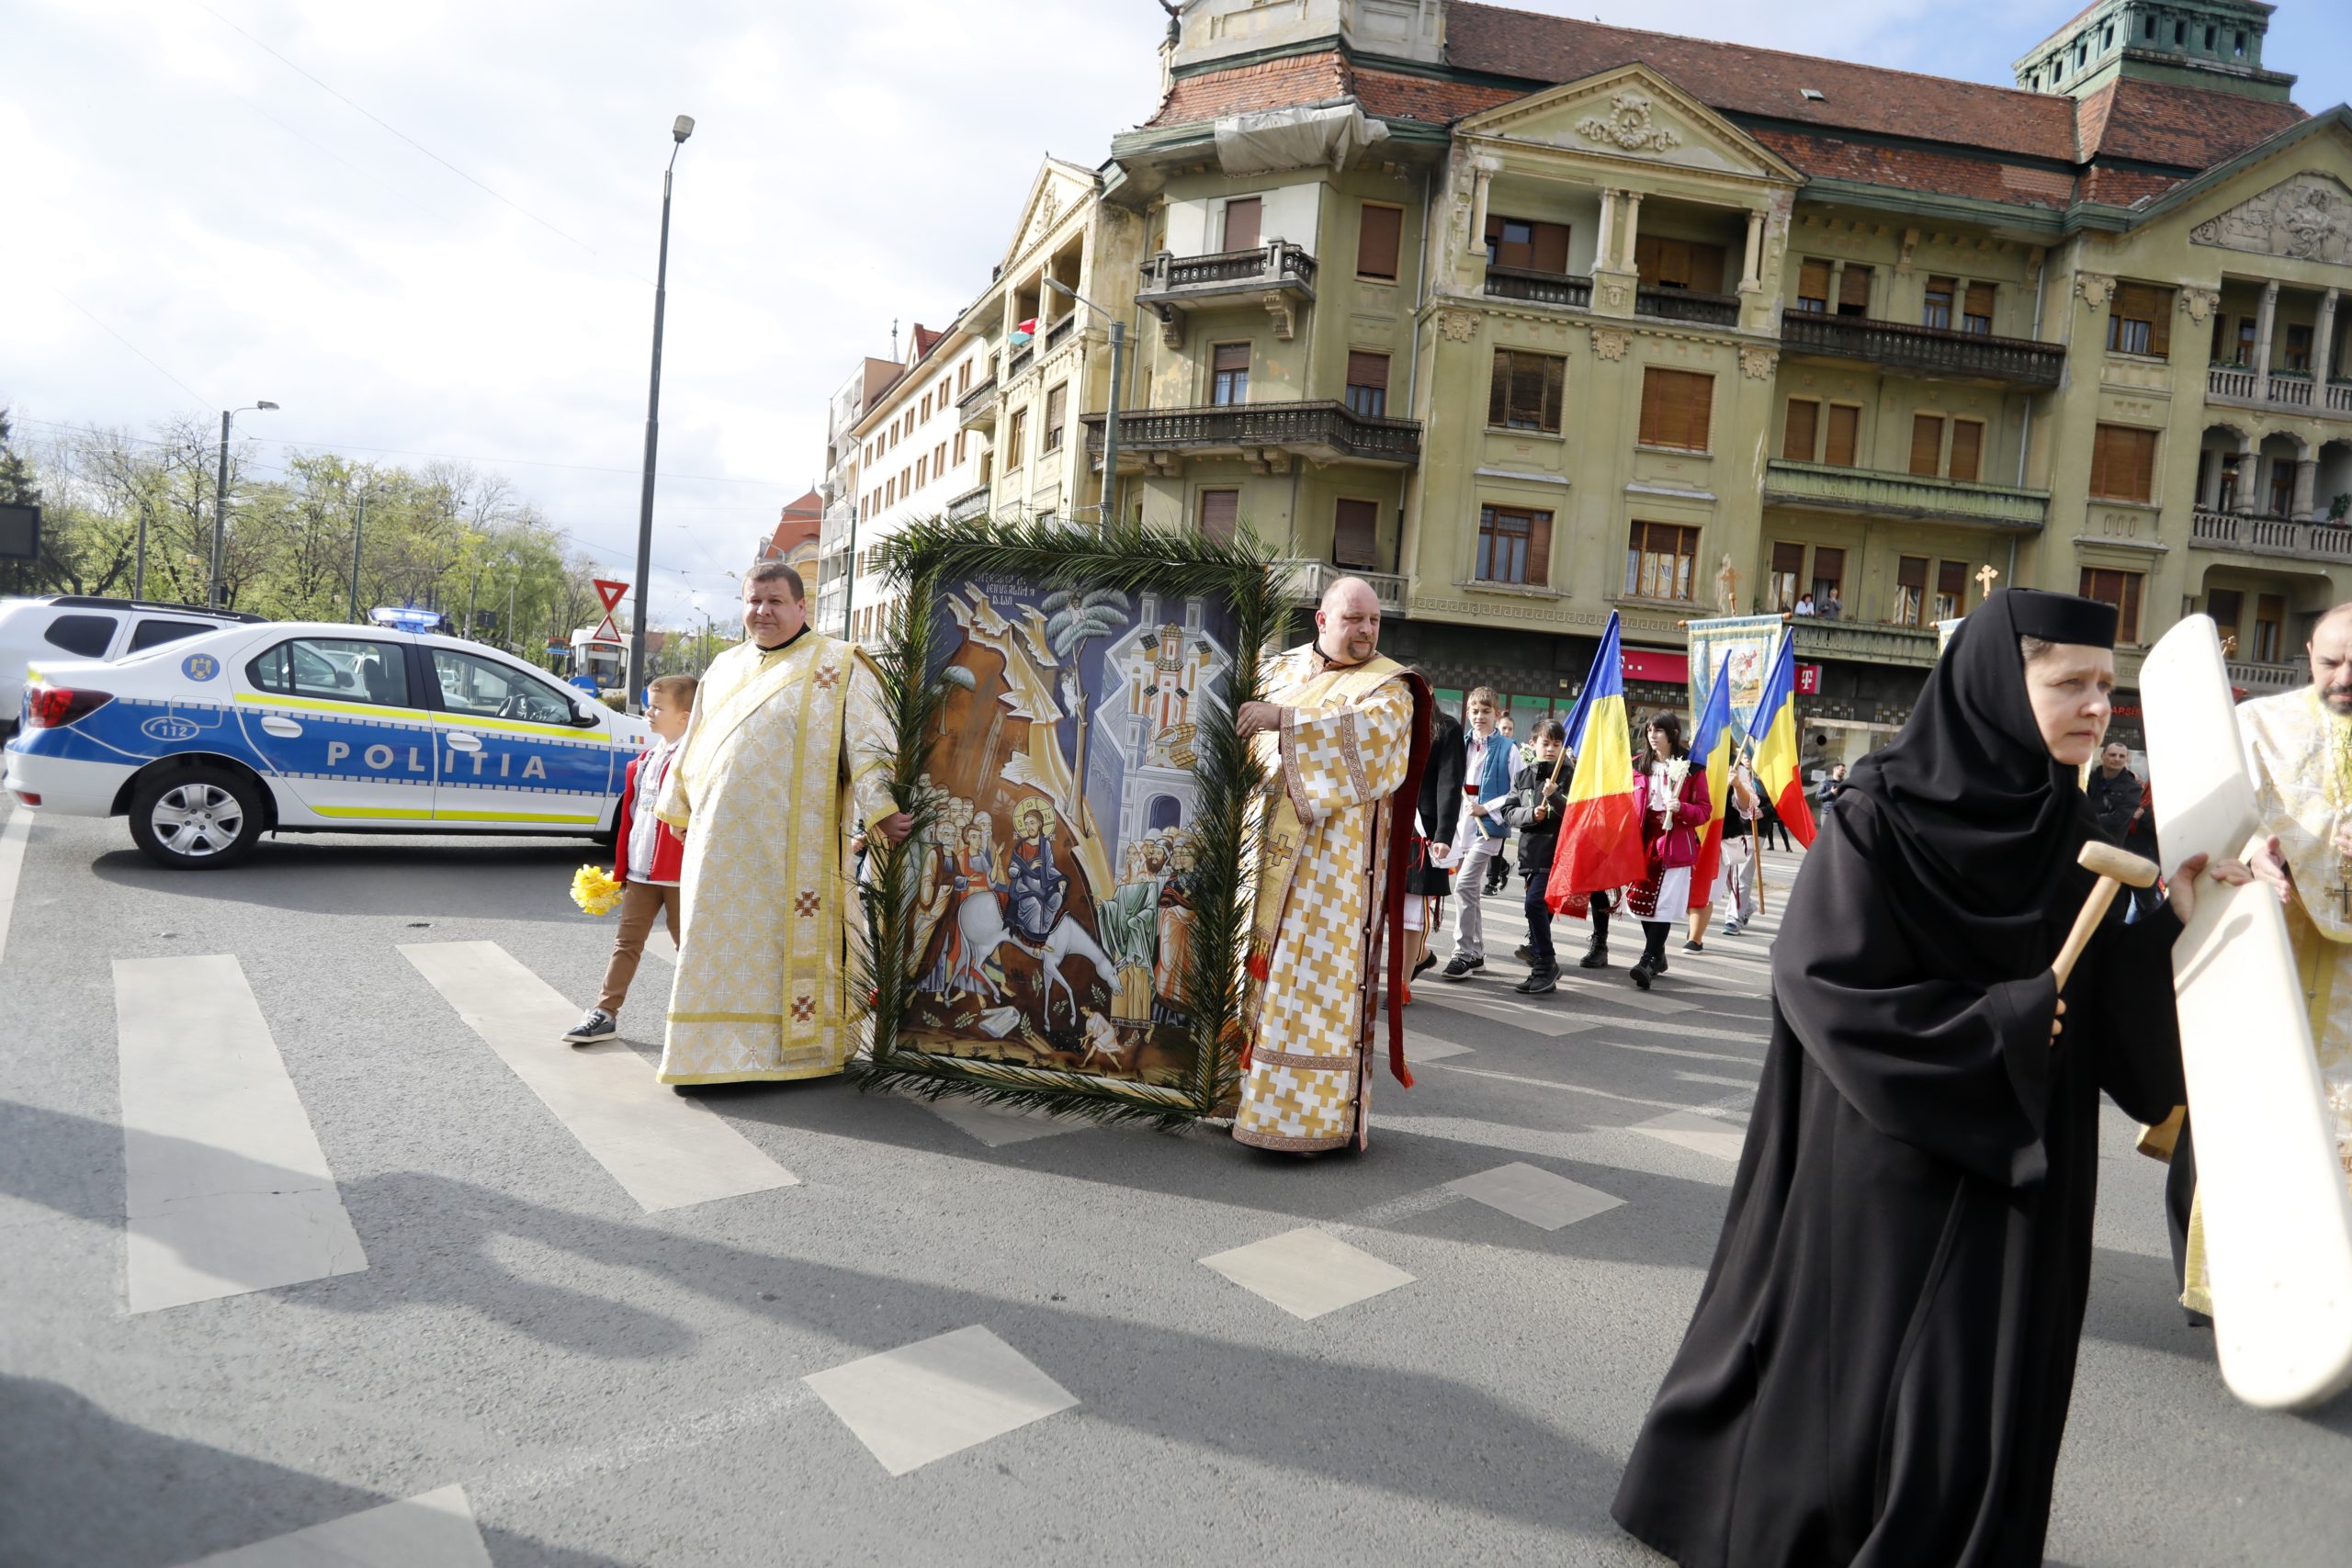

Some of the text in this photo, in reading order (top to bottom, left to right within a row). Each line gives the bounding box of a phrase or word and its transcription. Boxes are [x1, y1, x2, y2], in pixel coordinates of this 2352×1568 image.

[1802, 670, 1813, 690] T
[162, 726, 187, 737] 112
[327, 741, 547, 779] POLITIA
